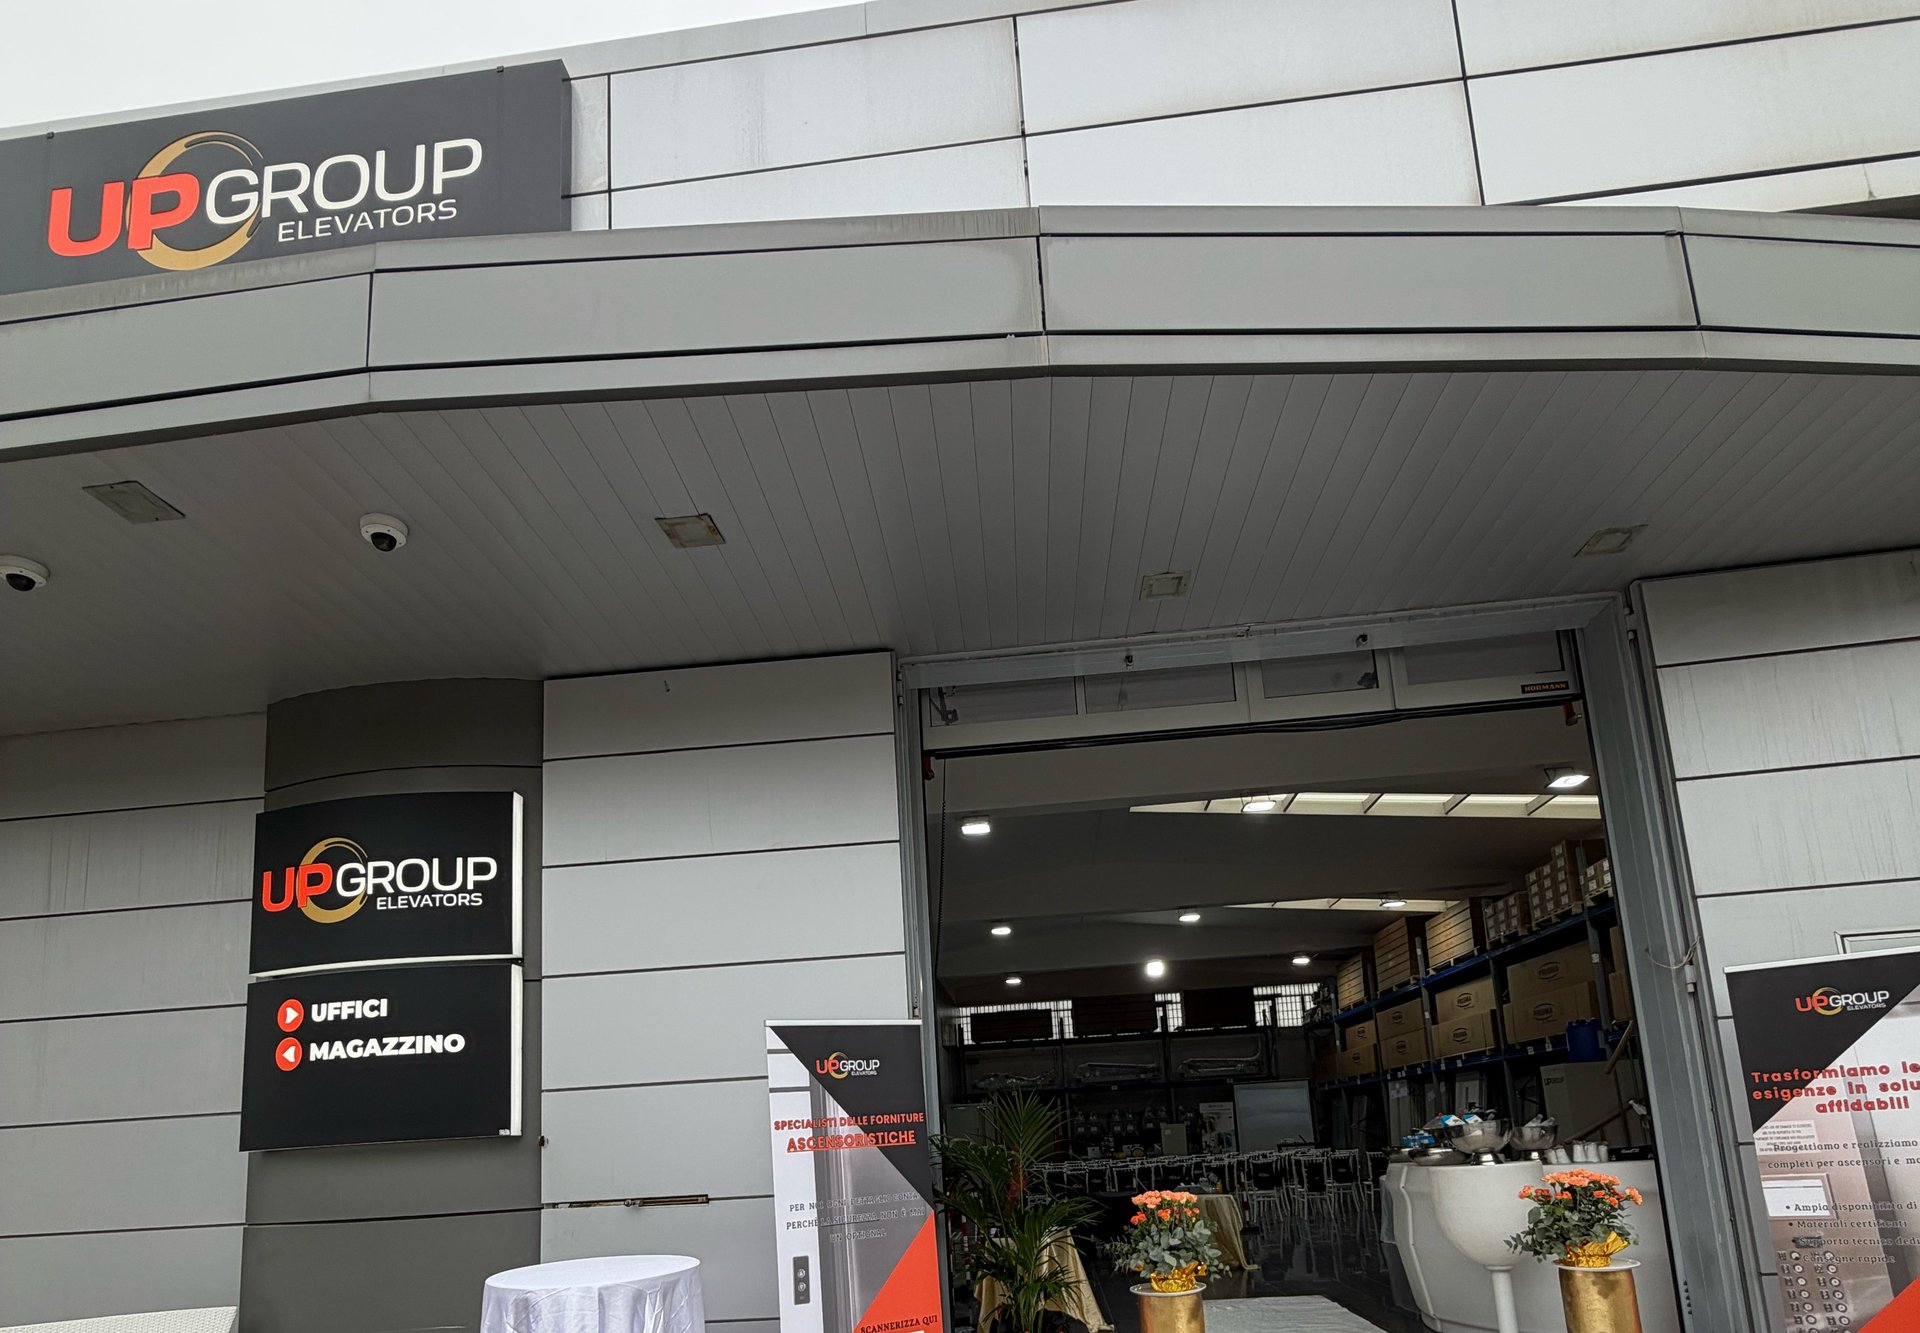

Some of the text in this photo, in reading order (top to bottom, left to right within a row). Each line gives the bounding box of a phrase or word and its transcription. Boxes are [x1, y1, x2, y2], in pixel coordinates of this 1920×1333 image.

[277, 199, 457, 242] ELEVATORS
[376, 892, 483, 910] ELEVATORS
[310, 999, 388, 1022] UFFICI
[1846, 1002, 1887, 1011] ELEVATORS
[309, 1033, 466, 1061] MAGAZZINO
[1751, 1061, 1920, 1083] Trasformiamo le
[1752, 1085, 1837, 1101] esigenze
[1847, 1081, 1867, 1095] in
[1815, 1096, 1910, 1114] affidabili
[774, 1112, 924, 1131] SPECIALISTI DELLE FORNITURE
[786, 1130, 916, 1153] ASCENSORISTICHE
[1774, 1142, 1840, 1153] Progettiamo
[1851, 1138, 1918, 1149] realizziamo
[1768, 1160, 1814, 1170] completi
[1816, 1160, 1834, 1169] per
[1837, 1157, 1891, 1167] ascensori
[789, 1203, 805, 1212] PER
[1794, 1203, 1829, 1213] Ampia
[1906, 1201, 1918, 1210] di
[1797, 1220, 1848, 1228] Materiali
[1800, 1237, 1849, 1247] Supporto
[1852, 1237, 1892, 1246] tecnico
[1803, 1254, 1855, 1264] Consegne
[860, 1315, 938, 1333] SCANNERIZZA QUI
